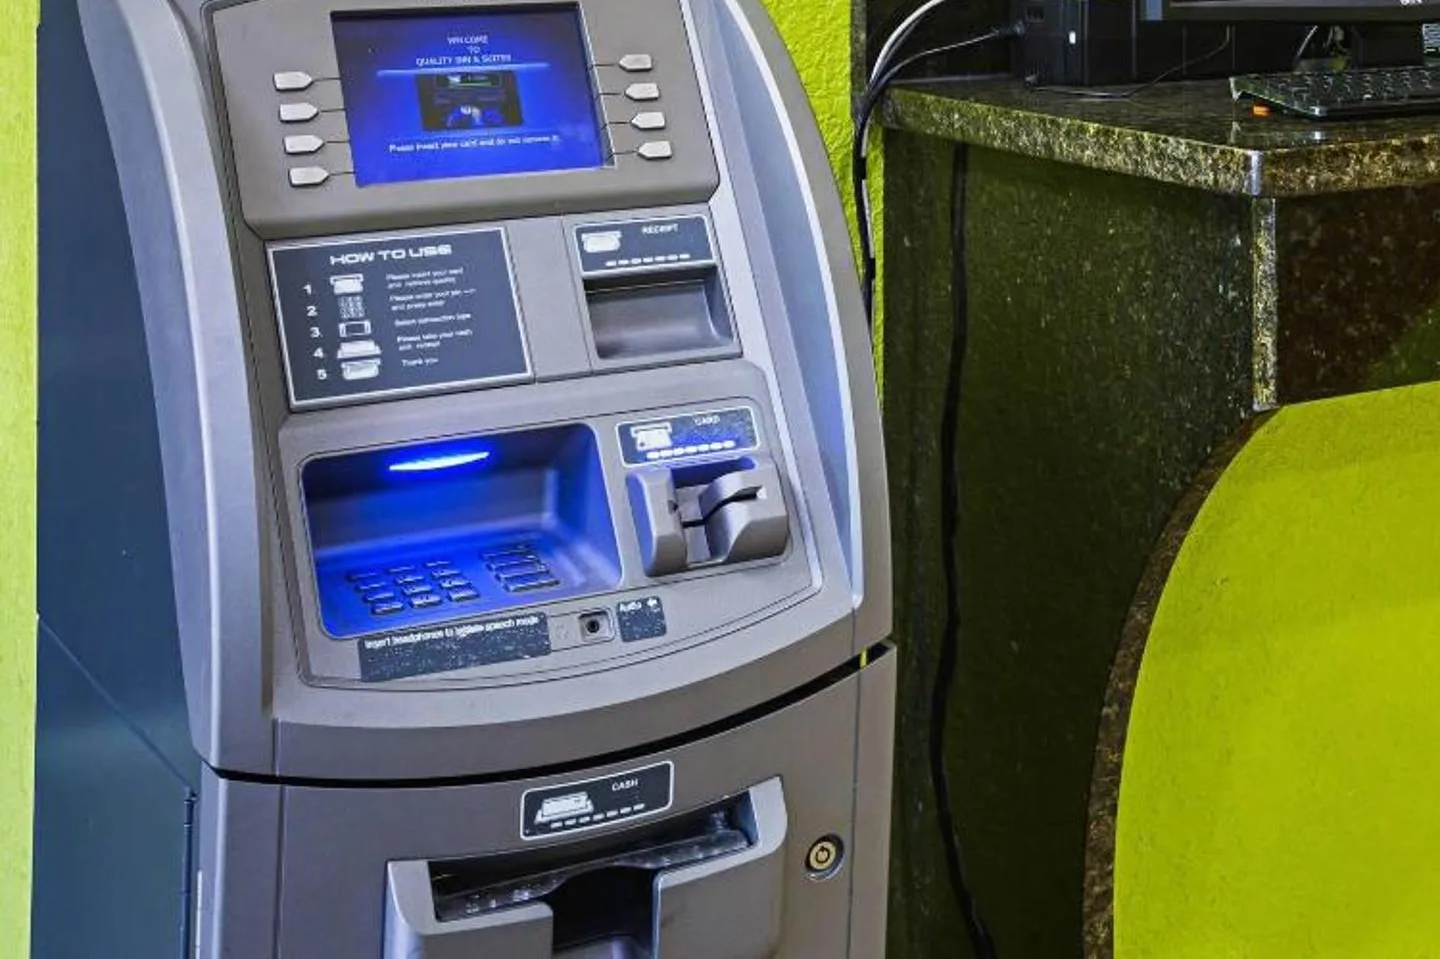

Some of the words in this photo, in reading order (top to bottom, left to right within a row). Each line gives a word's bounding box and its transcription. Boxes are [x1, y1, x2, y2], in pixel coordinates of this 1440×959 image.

[446, 34, 488, 45] WELCOME
[416, 55, 452, 67] QUALITY
[329, 251, 375, 265] HOW
[377, 249, 406, 261] TO
[409, 244, 452, 258] USE
[401, 356, 423, 368] Thank
[611, 777, 639, 792] CASH
